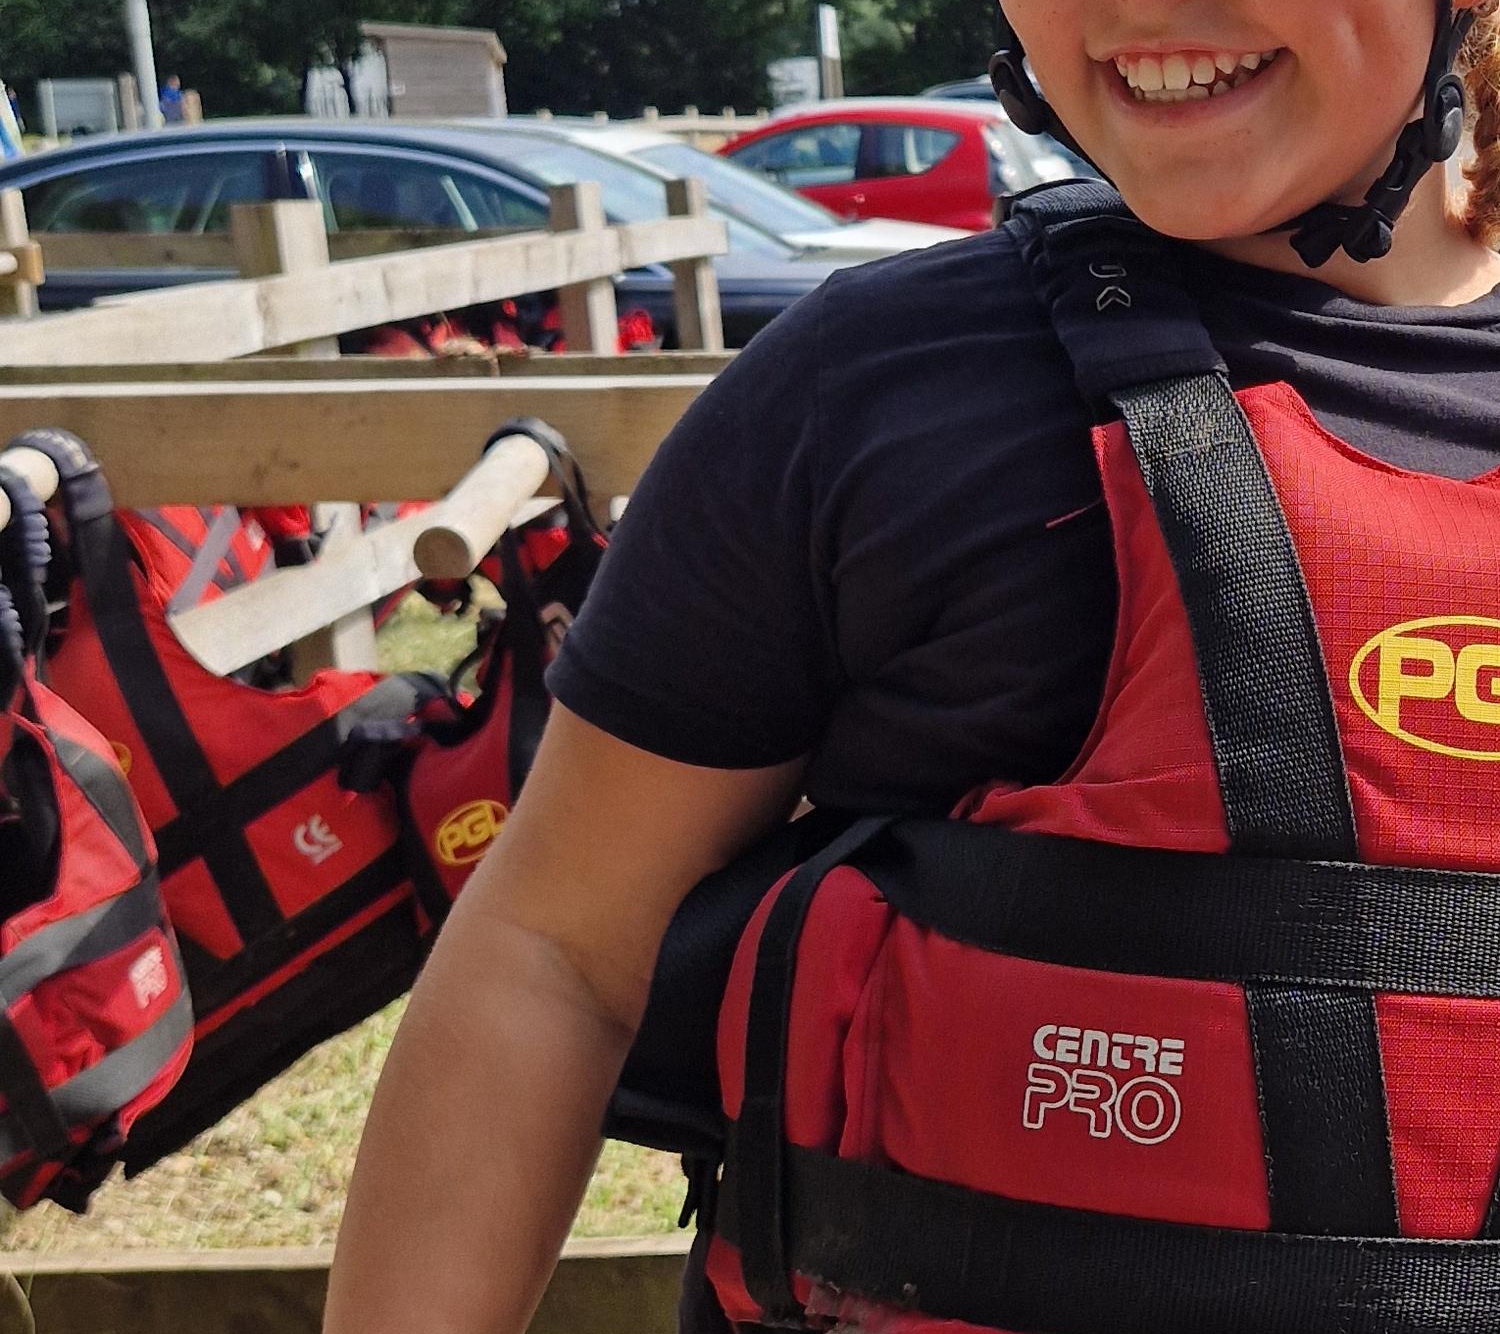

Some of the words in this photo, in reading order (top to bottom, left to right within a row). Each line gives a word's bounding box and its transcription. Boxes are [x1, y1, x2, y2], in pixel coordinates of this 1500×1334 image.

[437, 800, 504, 860] PGL
[1033, 1024, 1185, 1076] CENTRE
[1022, 1062, 1182, 1145] PRO
